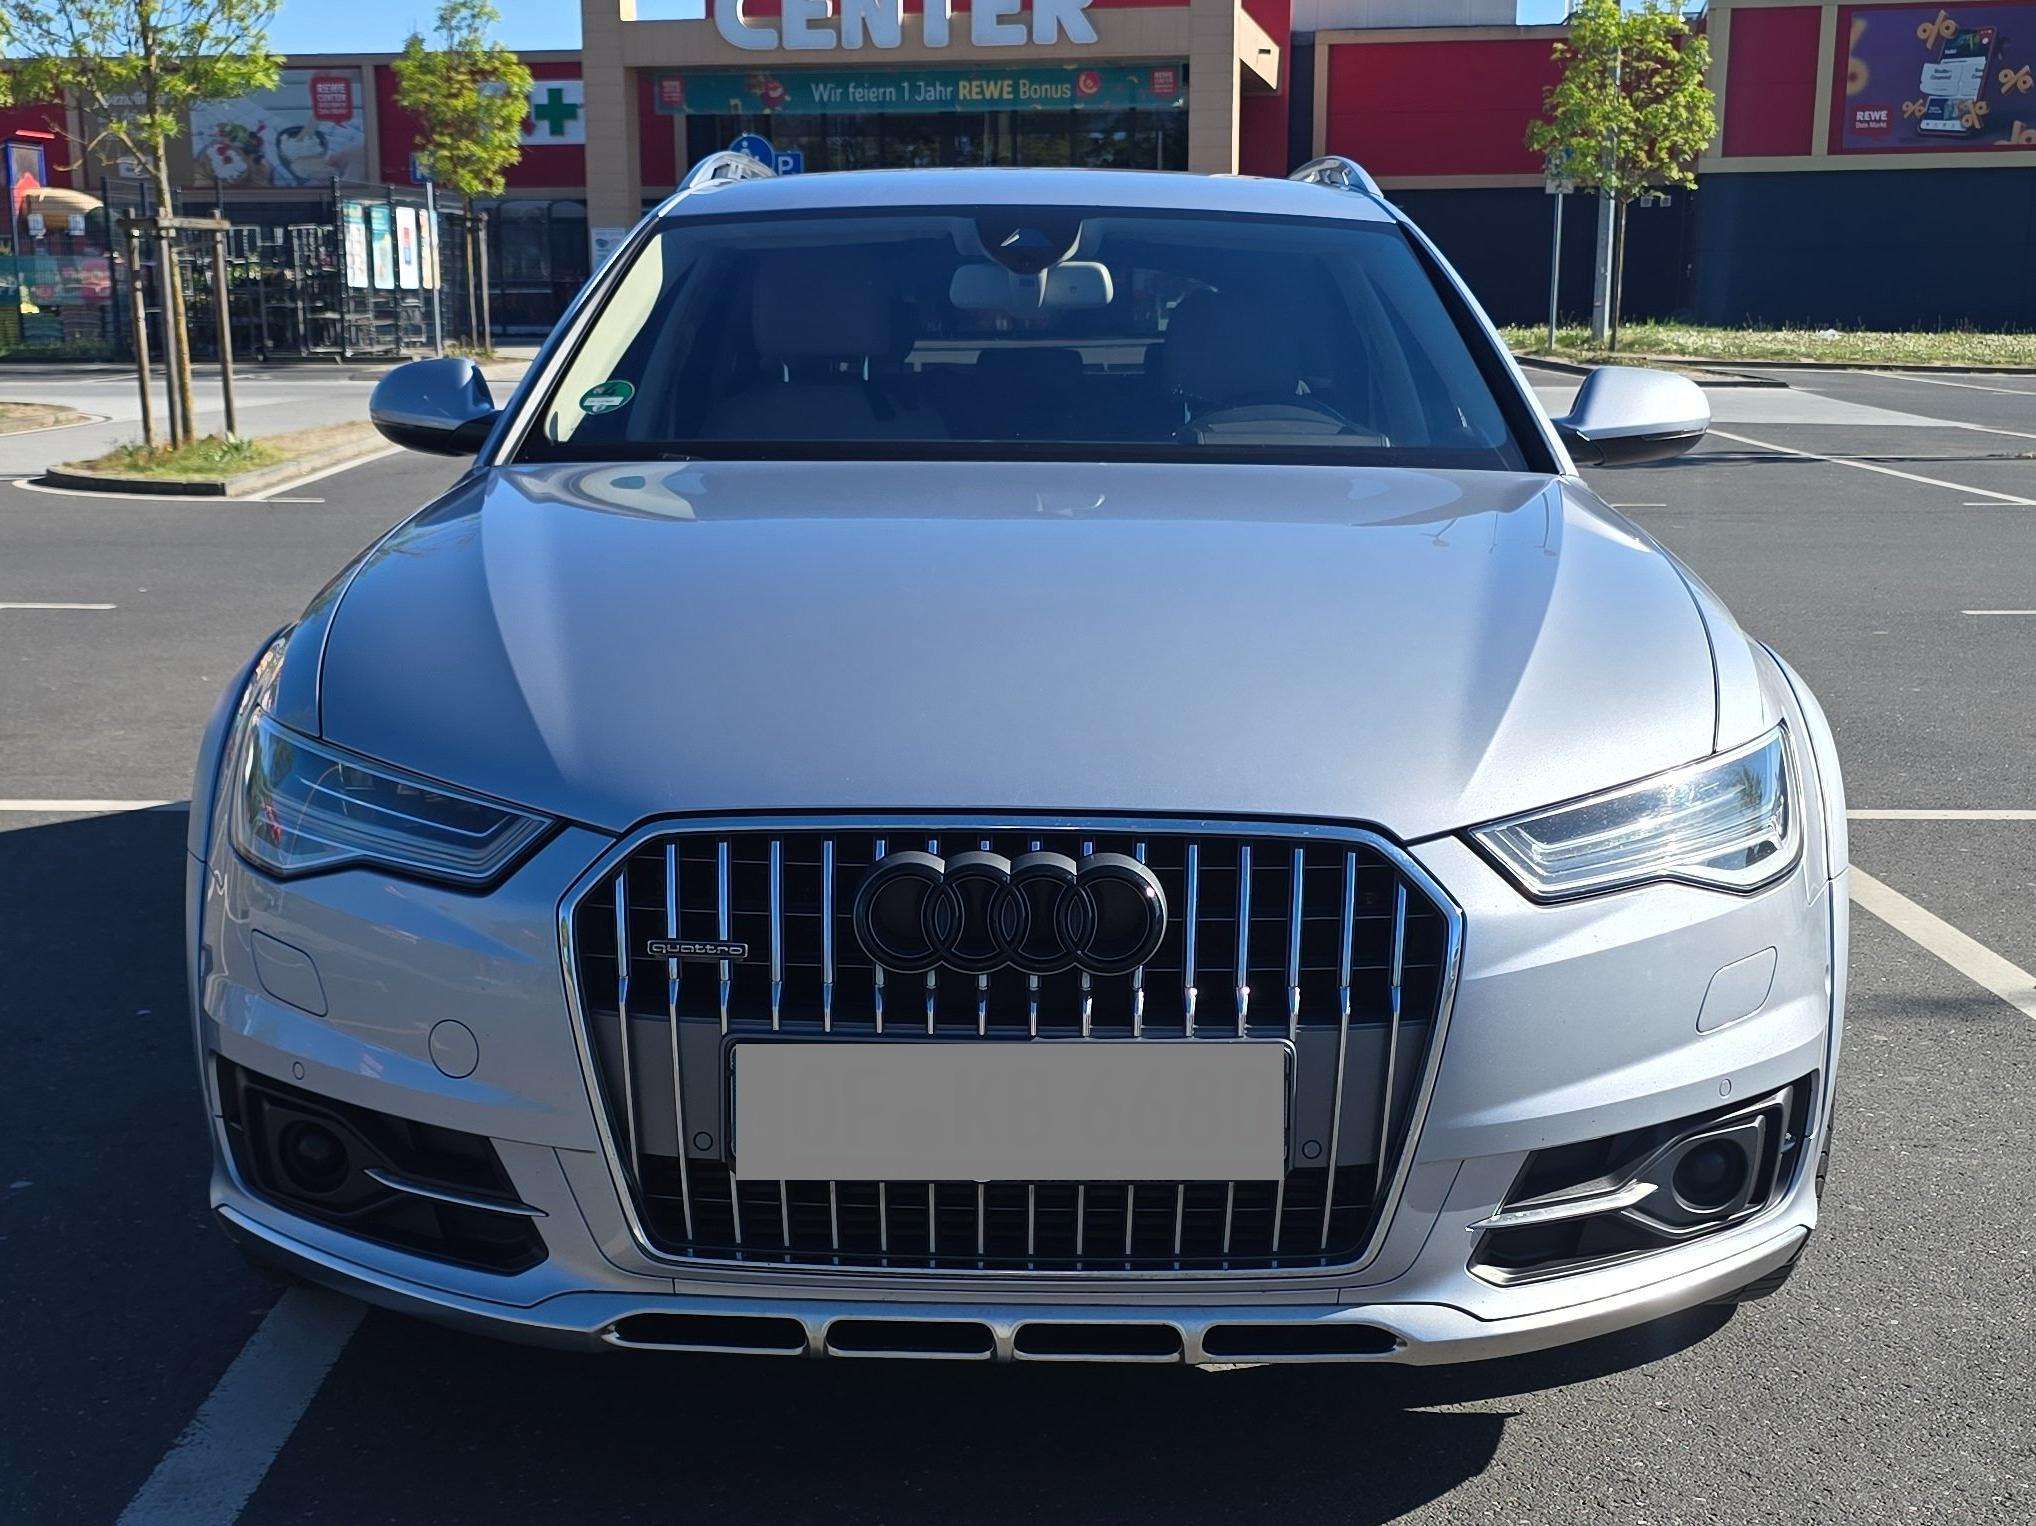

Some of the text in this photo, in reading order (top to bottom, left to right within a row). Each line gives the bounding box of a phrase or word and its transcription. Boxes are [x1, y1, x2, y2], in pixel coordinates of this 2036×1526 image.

[714, 0, 1099, 50] CENTER
[811, 78, 1072, 102] Wir feiern 1 Jahr REWE Bonus
[1856, 110, 1888, 121] REWE
[652, 943, 743, 955] quattro
